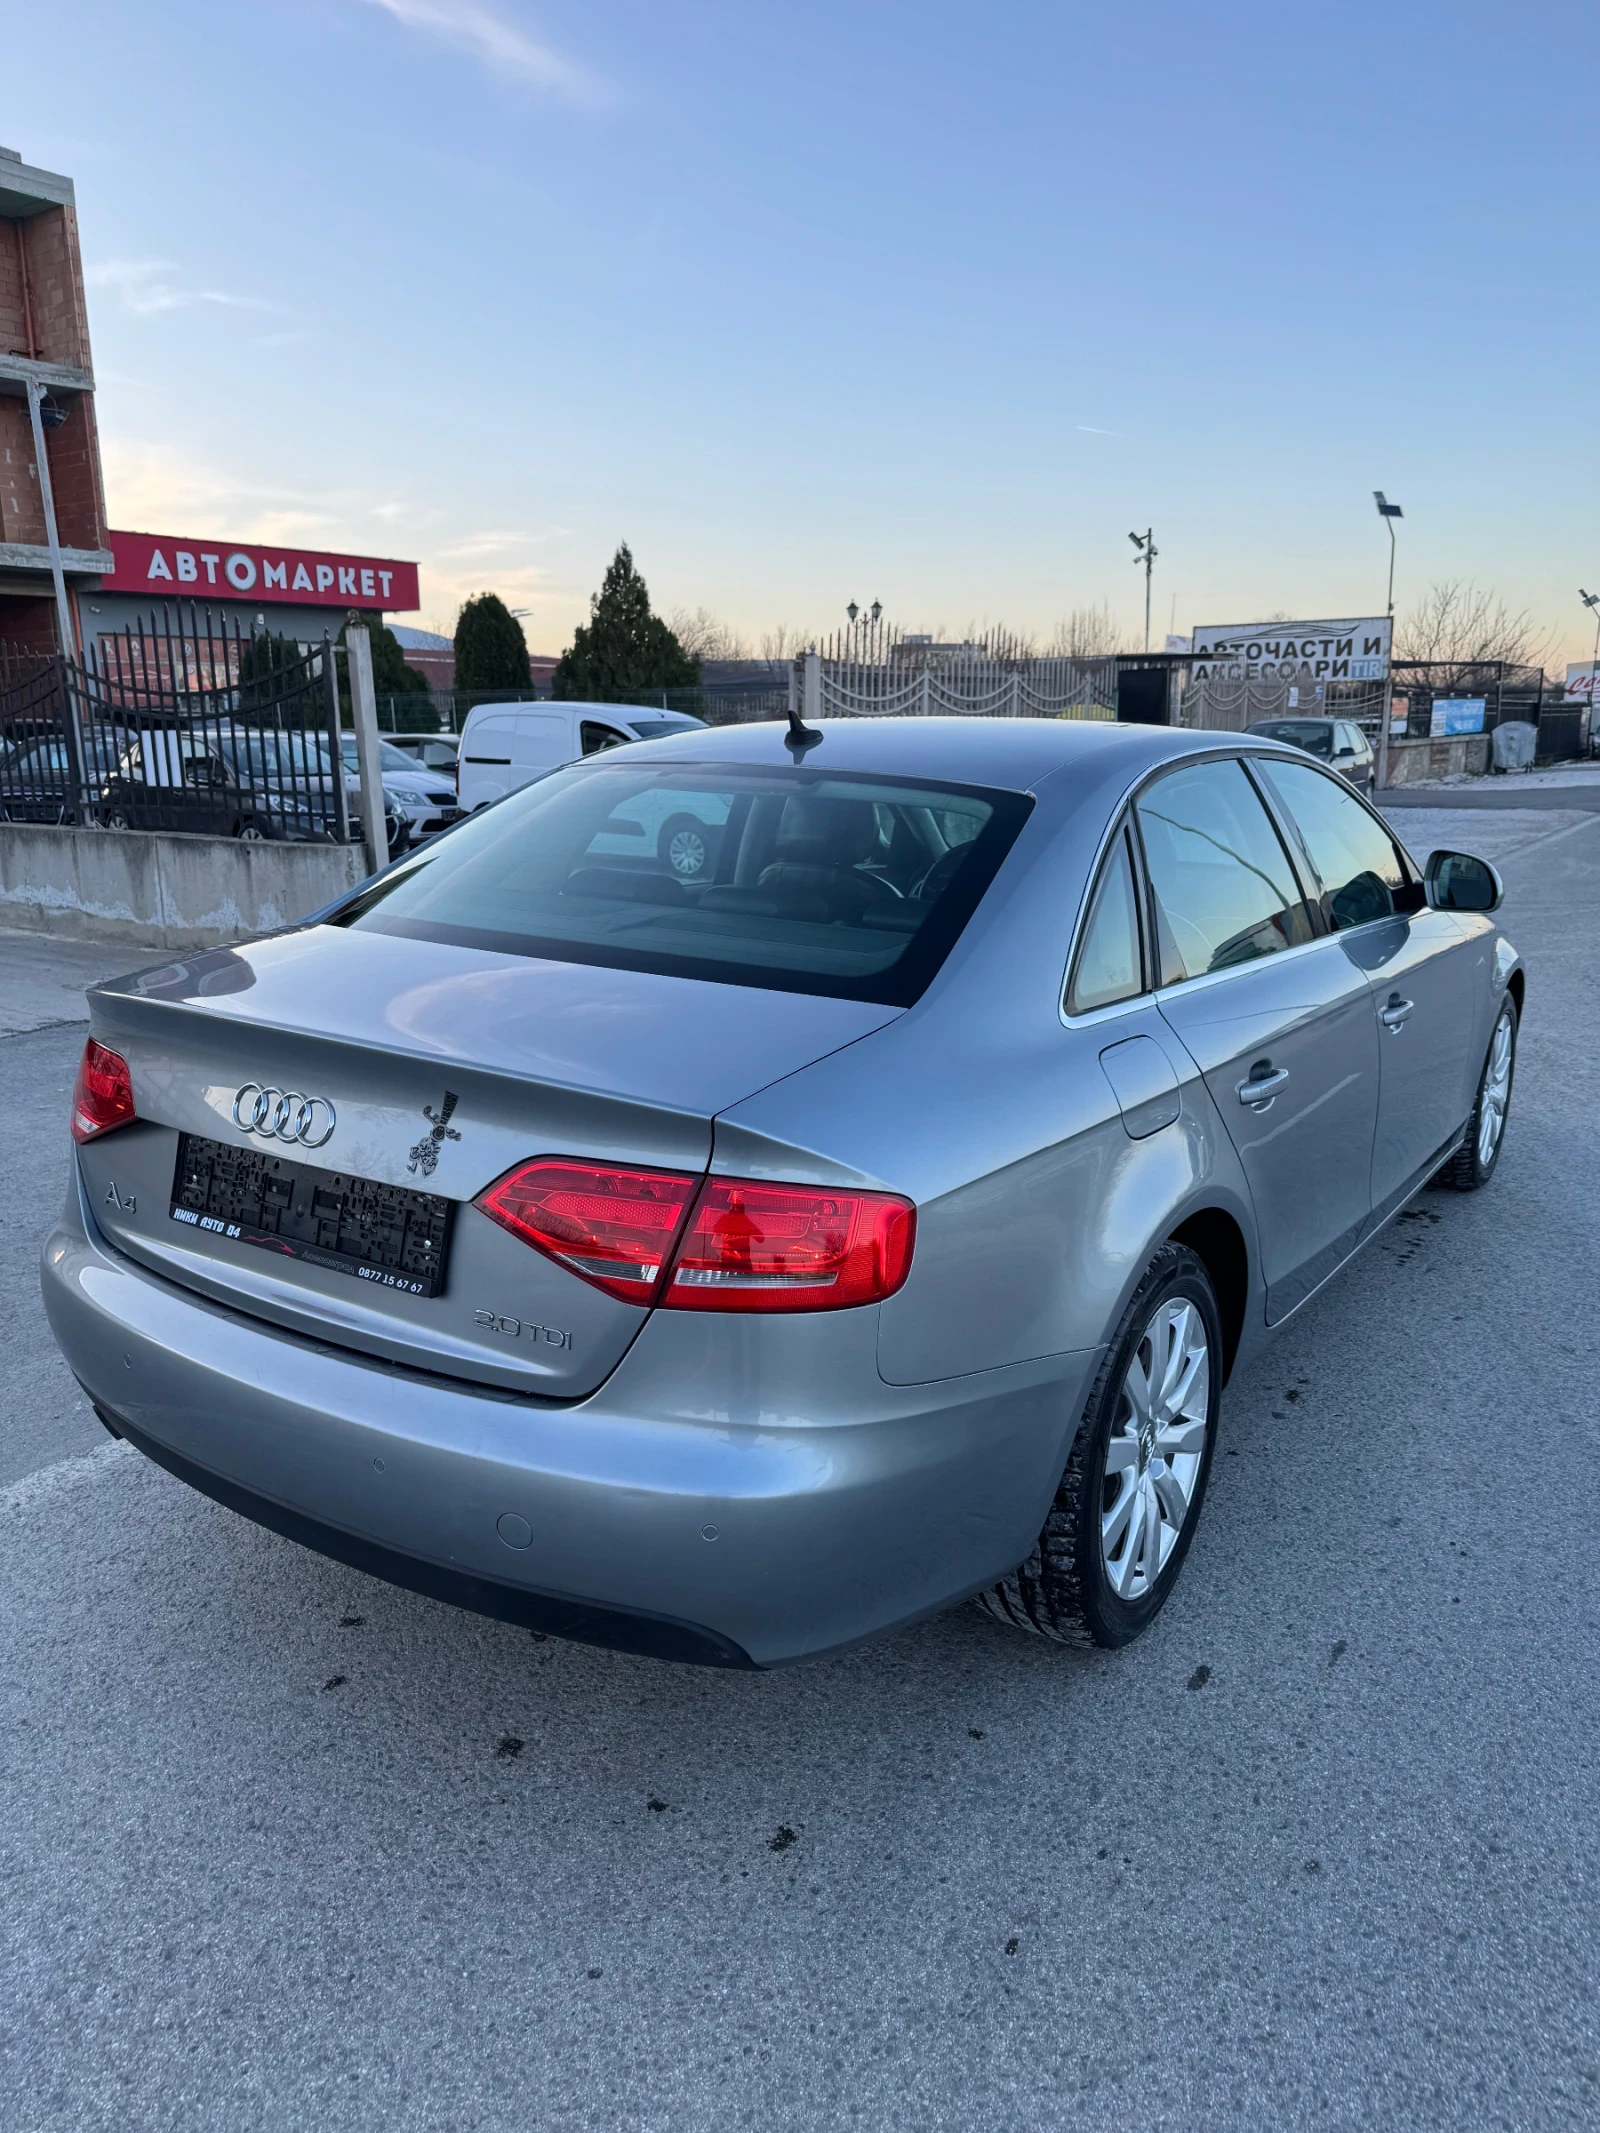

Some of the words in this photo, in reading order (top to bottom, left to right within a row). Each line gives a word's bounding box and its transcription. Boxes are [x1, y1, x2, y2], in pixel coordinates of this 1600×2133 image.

[147, 549, 393, 598] АВТОМАРКЕТ
[1363, 637, 1381, 655] И
[1352, 660, 1380, 677] TIR
[104, 1181, 137, 1215] A4
[173, 1208, 199, 1225] НИКИ
[200, 1216, 225, 1233] АУТО
[358, 1267, 382, 1281] 0877
[382, 1274, 395, 1286] 15
[396, 1278, 409, 1289] 67
[410, 1284, 423, 1294] 67
[474, 1309, 520, 1337] 2.0
[523, 1321, 572, 1350] TDI
